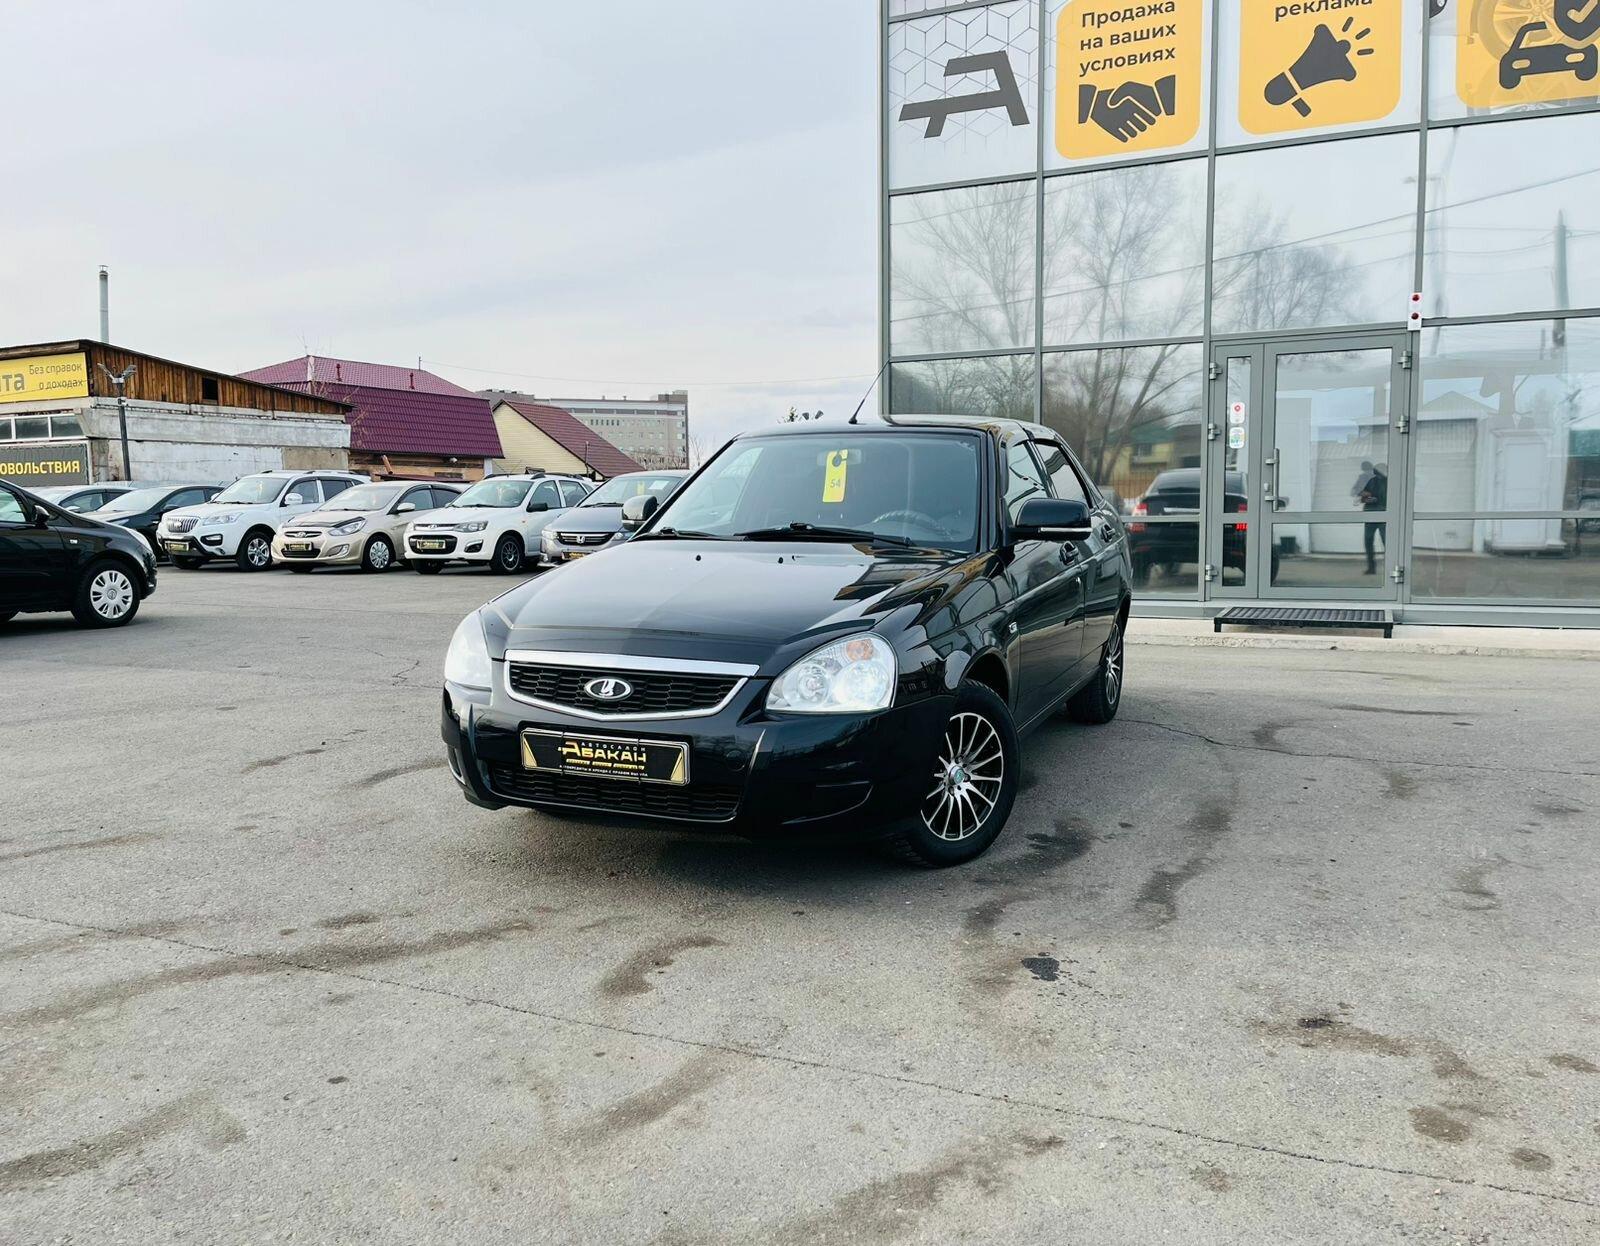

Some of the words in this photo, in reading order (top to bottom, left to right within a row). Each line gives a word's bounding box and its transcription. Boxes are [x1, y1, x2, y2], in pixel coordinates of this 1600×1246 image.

[1082, 0, 1175, 28] Продажа
[1080, 37, 1103, 51] на
[1110, 24, 1176, 46] ваших
[1079, 47, 1176, 77] условиях
[28, 364, 44, 375] Без
[46, 362, 82, 376] справок
[0, 373, 25, 392] та
[39, 381, 44, 390] о
[45, 379, 83, 390] доходах
[830, 479, 840, 488] 54
[581, 741, 646, 752] АВТОСАЛОН
